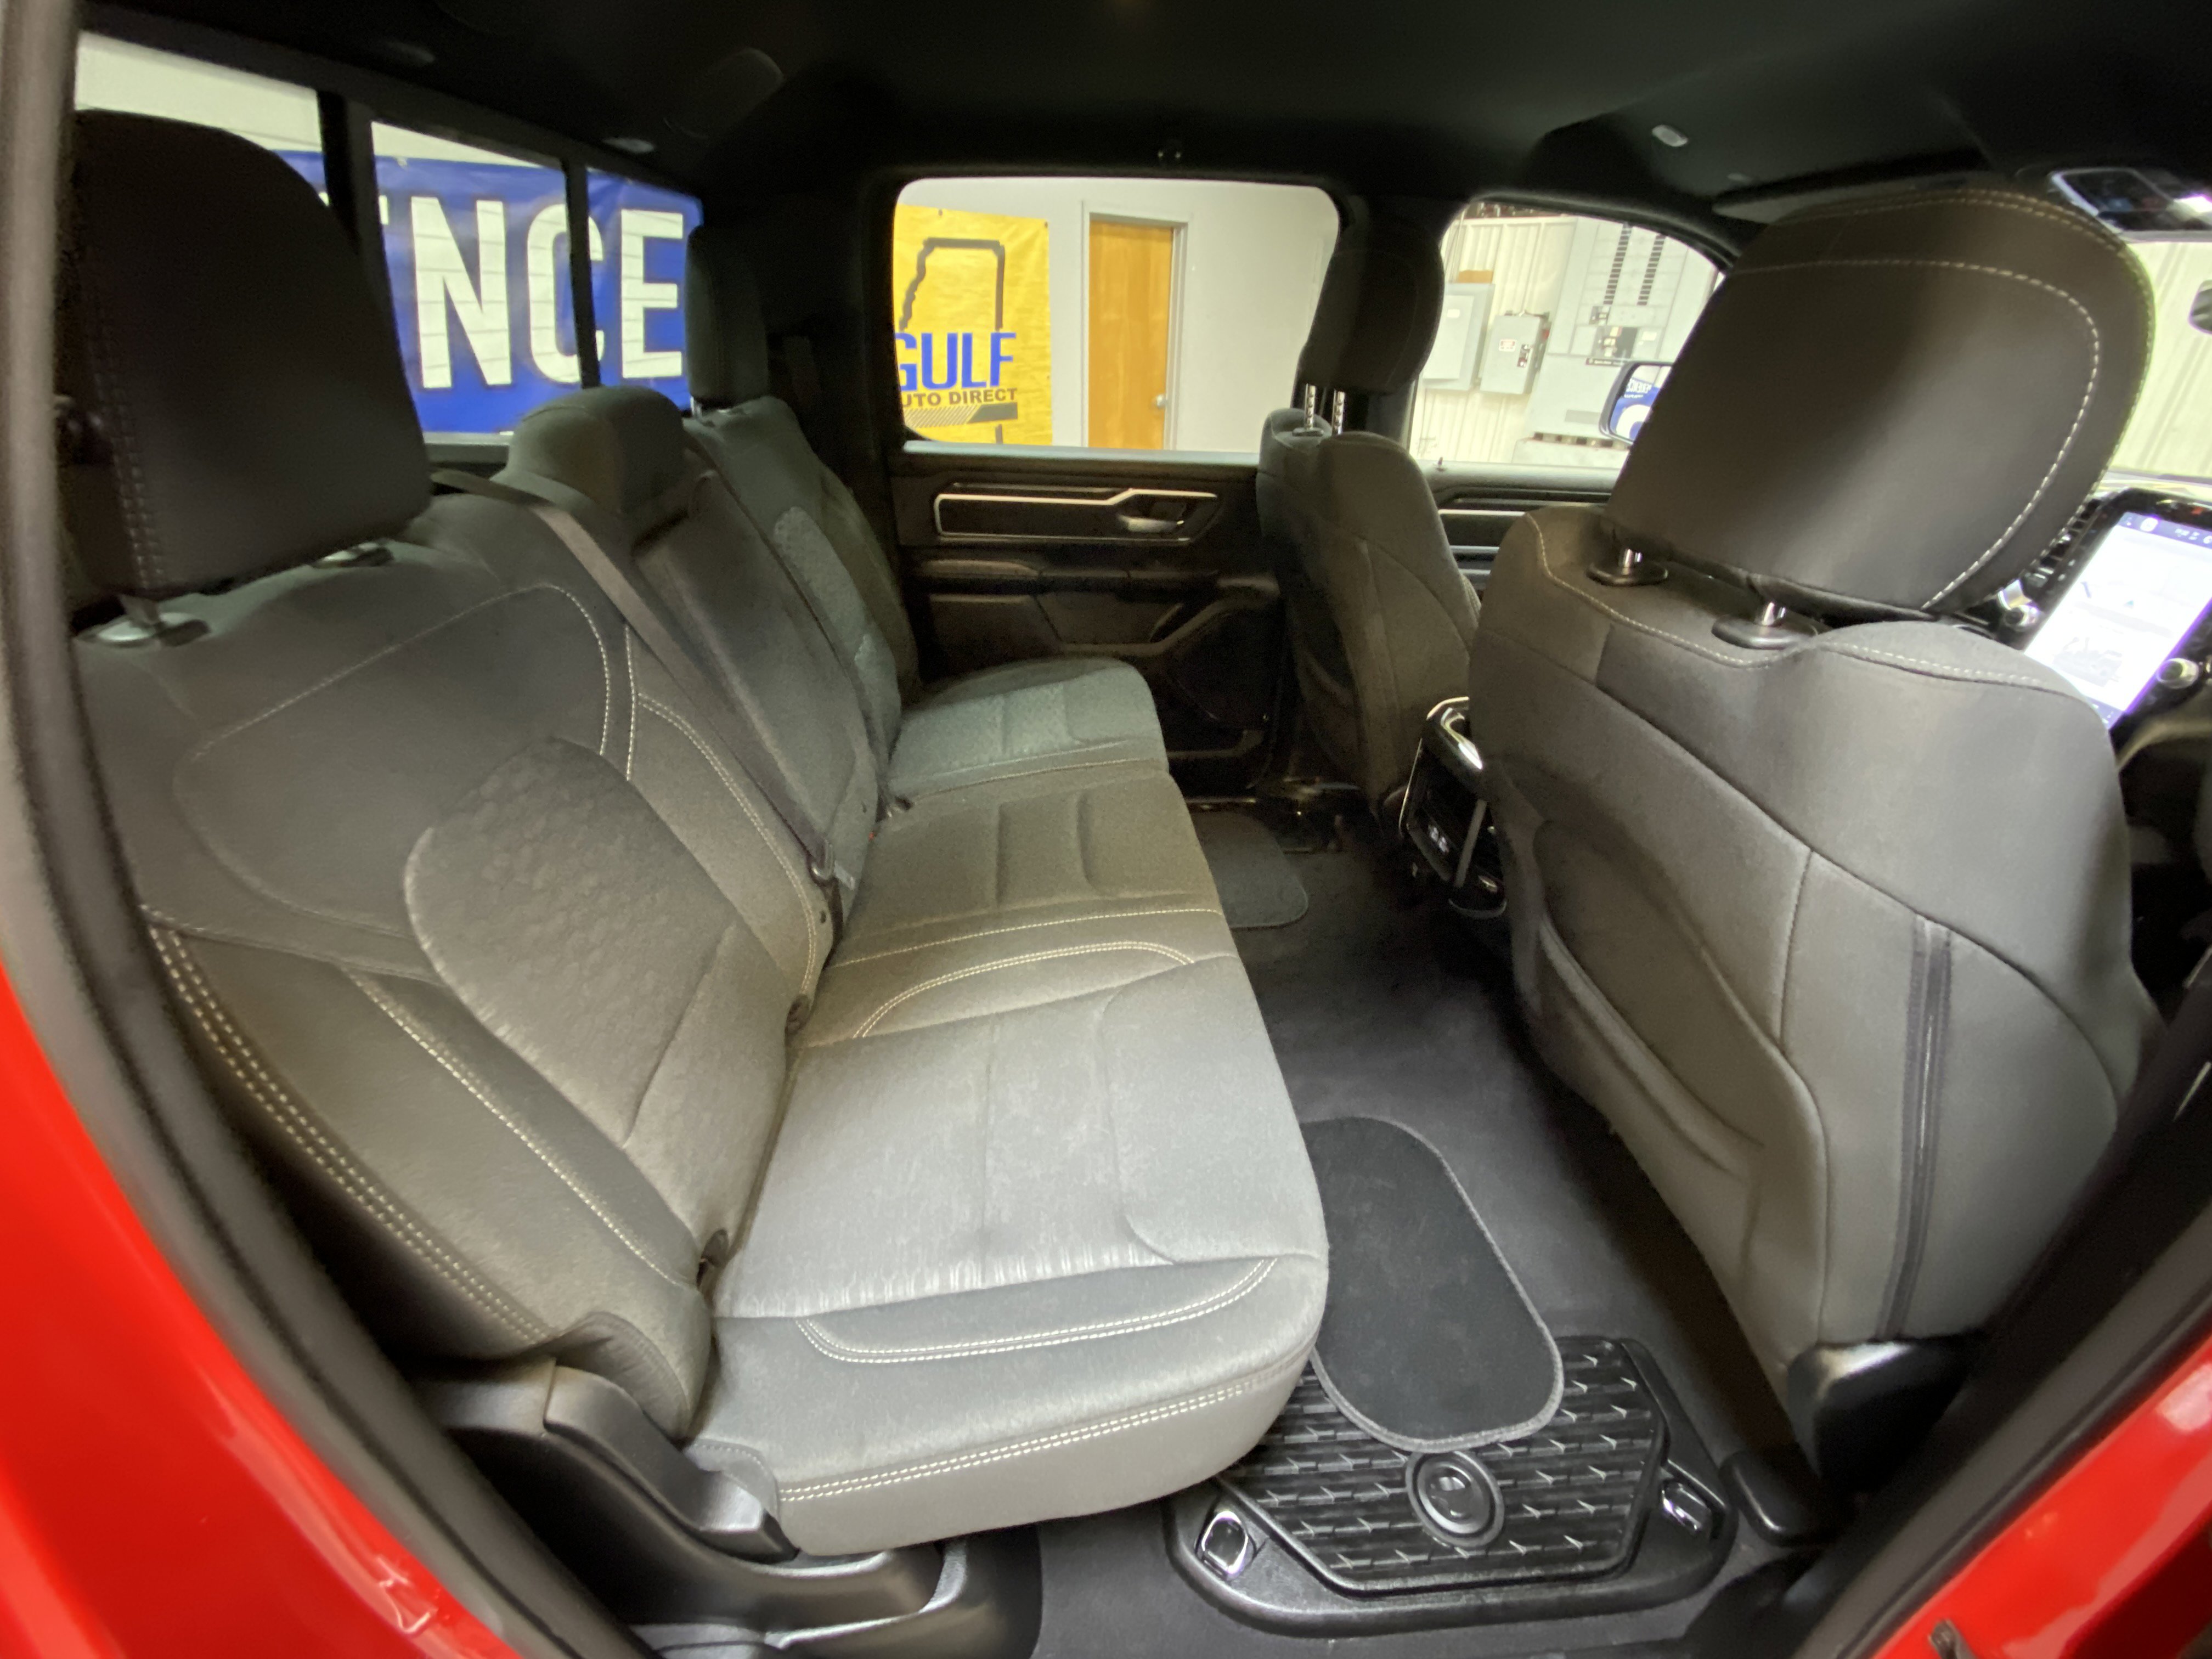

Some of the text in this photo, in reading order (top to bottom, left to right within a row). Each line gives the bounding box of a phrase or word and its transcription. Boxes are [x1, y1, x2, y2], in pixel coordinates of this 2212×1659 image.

[379, 195, 684, 388] NCE
[895, 332, 1017, 392] GULF
[902, 388, 1018, 407] UTO DIRECT
